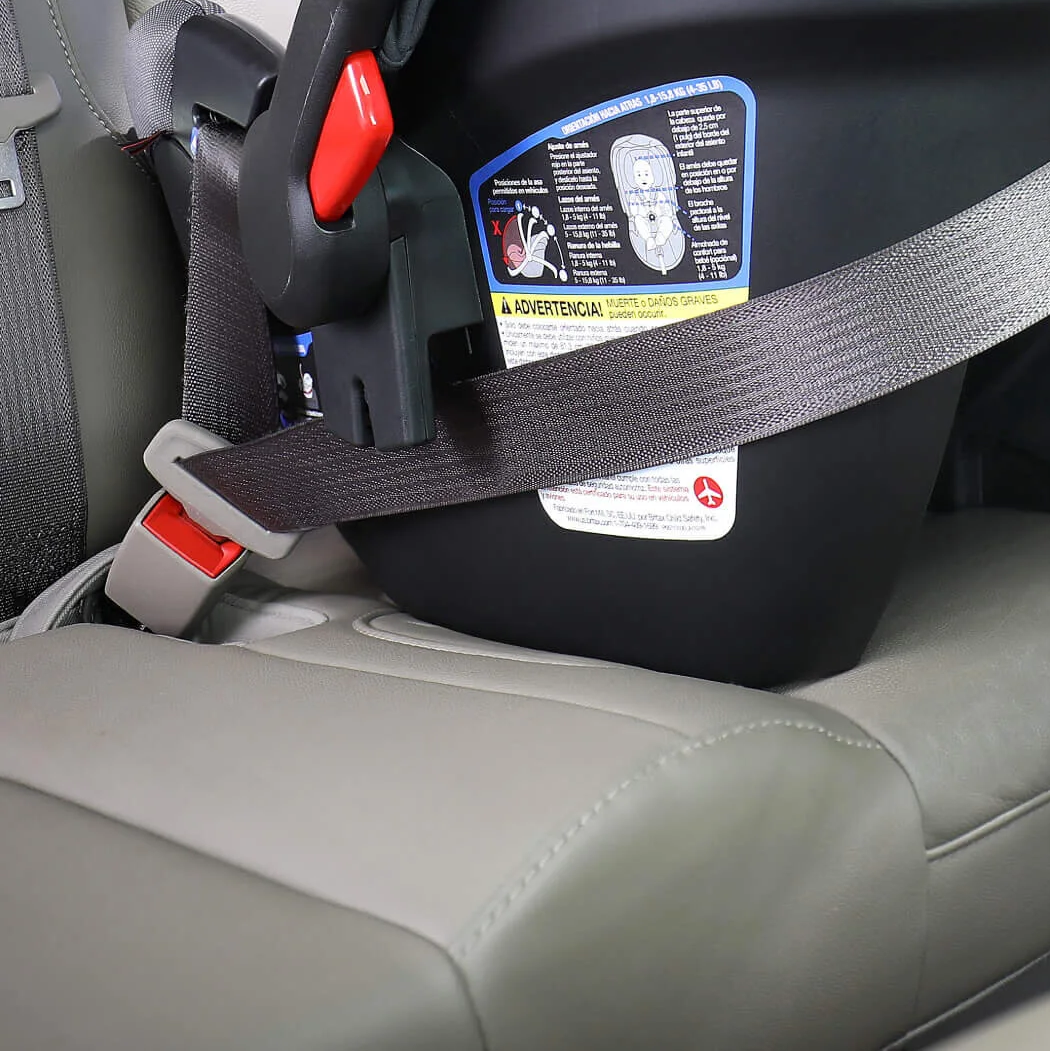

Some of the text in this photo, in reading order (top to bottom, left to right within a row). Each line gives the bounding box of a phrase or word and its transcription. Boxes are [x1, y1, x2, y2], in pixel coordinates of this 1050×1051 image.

[600, 105, 621, 119] HACIA
[674, 87, 687, 98] KG
[708, 78, 724, 91] LB)
[675, 109, 689, 118] parte
[690, 105, 712, 115] superior
[716, 113, 726, 121] por
[693, 131, 702, 139] del
[702, 130, 719, 138] borde
[720, 128, 730, 136] del
[565, 141, 572, 149] de
[695, 139, 704, 147] del
[717, 158, 737, 167] quedar
[727, 167, 736, 175] por
[708, 214, 716, 222] del
[515, 298, 603, 317] ADVERTENCIA!
[606, 297, 640, 308] MUERTE
[648, 295, 679, 307] DAÑOS
[680, 294, 719, 306] GRAVES
[608, 310, 637, 320] pueden
